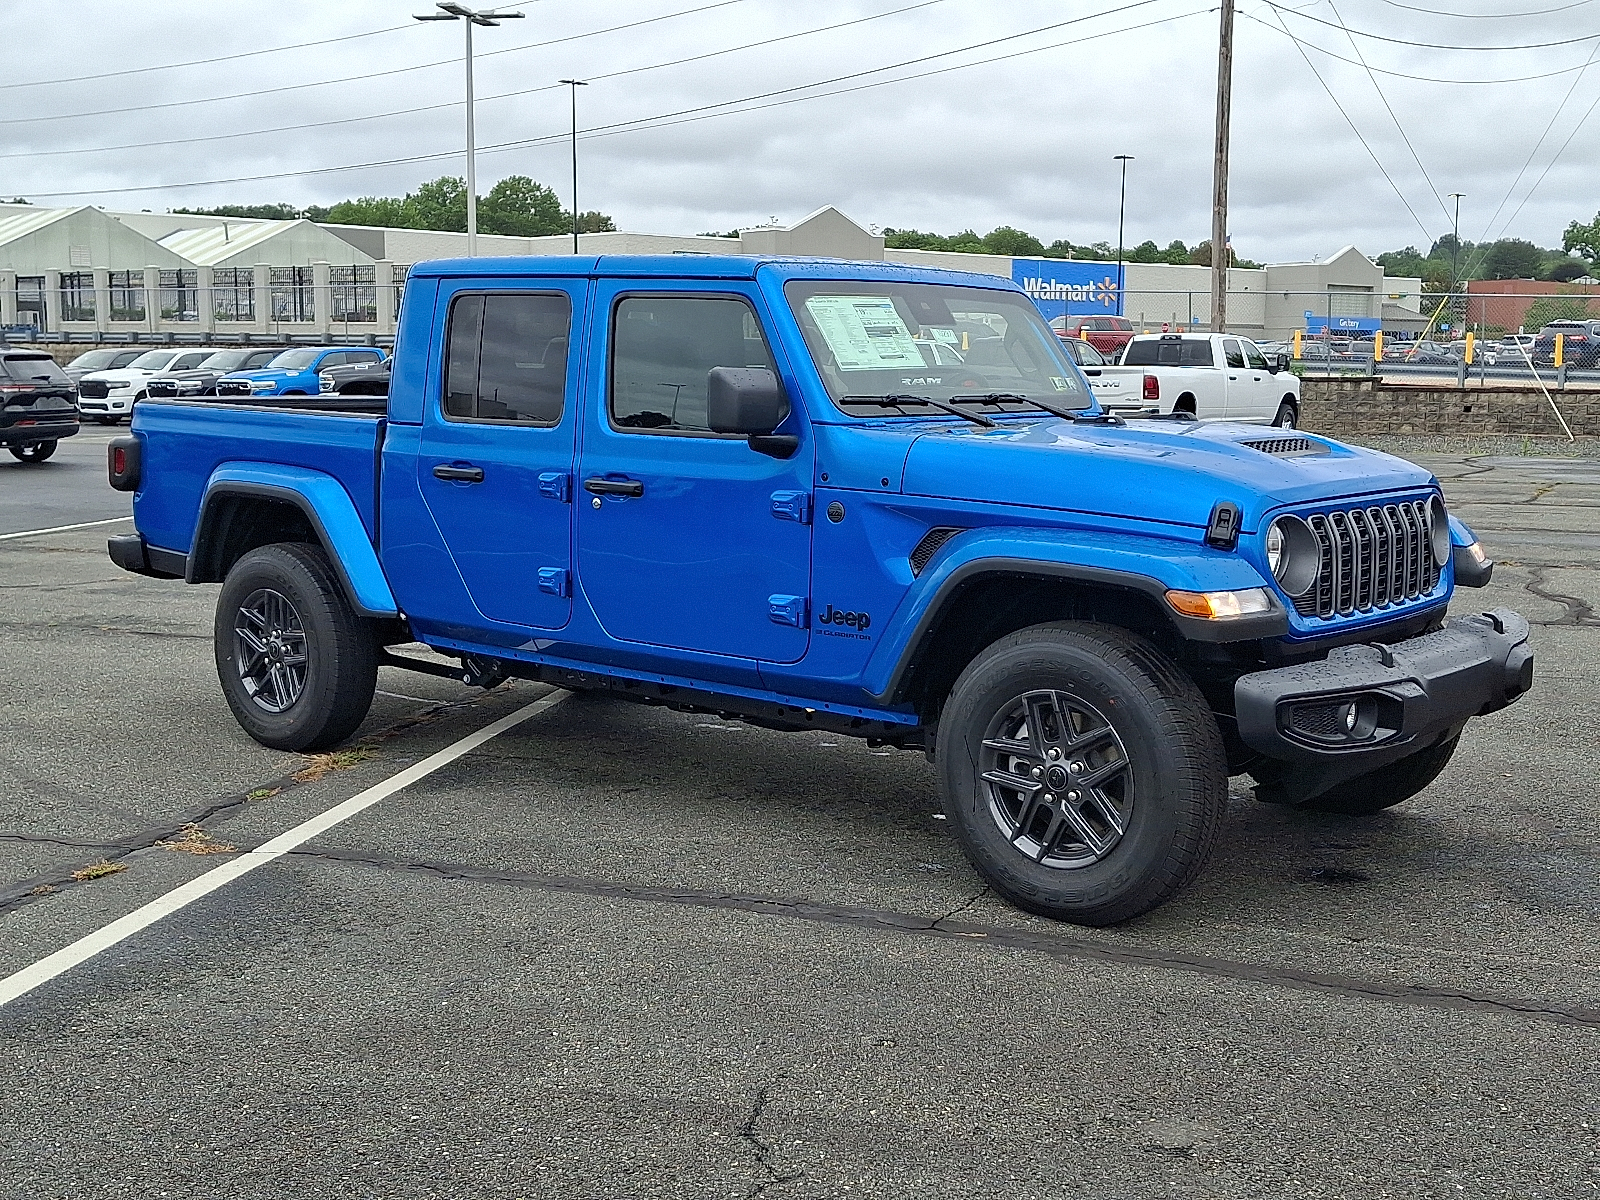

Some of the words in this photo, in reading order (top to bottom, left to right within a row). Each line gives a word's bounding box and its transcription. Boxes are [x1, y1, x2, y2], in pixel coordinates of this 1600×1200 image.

[1023, 276, 1096, 302] Walmart
[901, 377, 942, 386] RAM
[819, 603, 871, 632] Jeep
[823, 629, 871, 641] GLADIATOR
